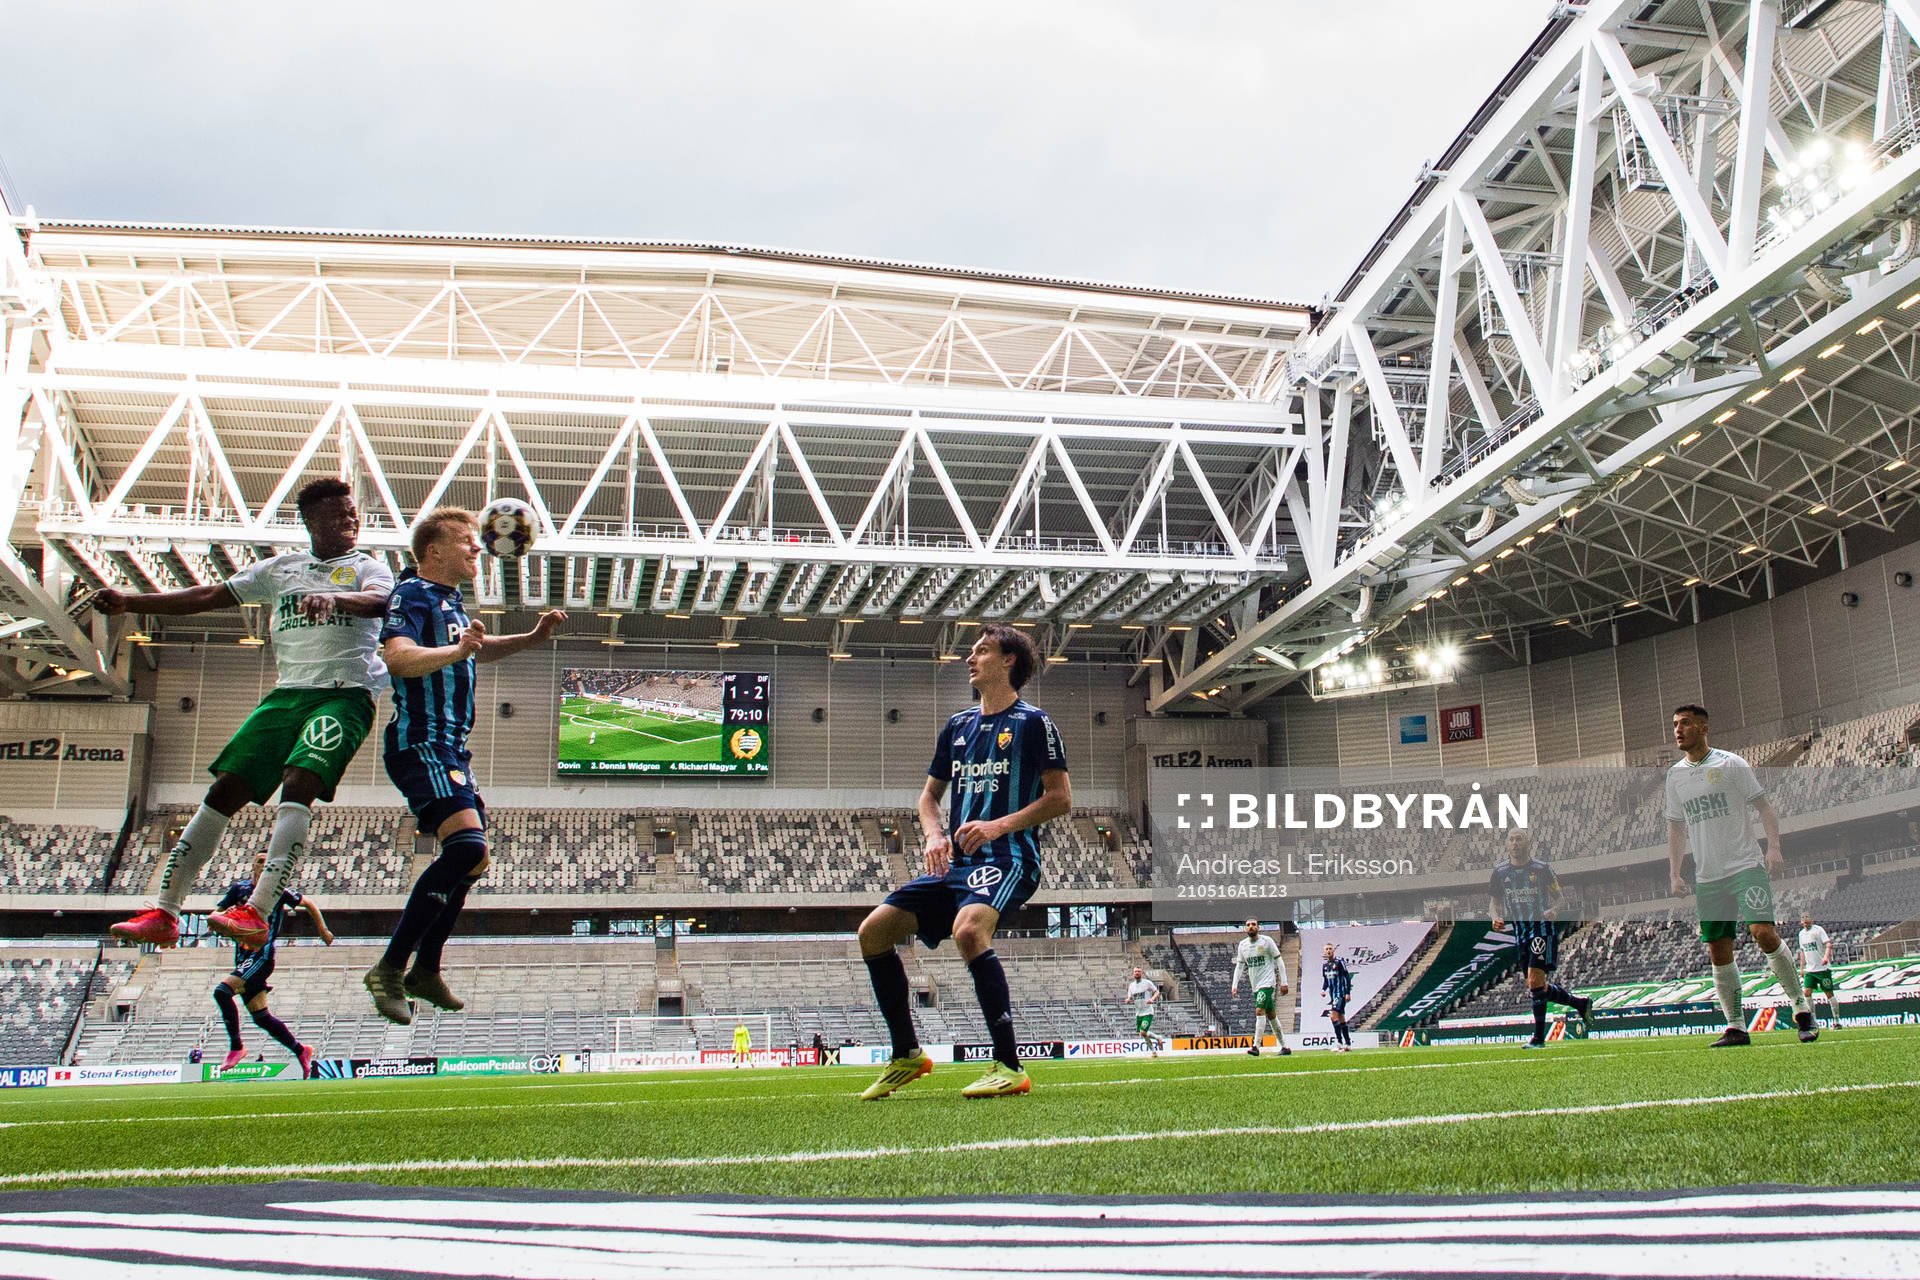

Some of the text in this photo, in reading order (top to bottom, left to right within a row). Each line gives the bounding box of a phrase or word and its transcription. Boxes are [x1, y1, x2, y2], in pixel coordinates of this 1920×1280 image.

[757, 675, 769, 683] DIF
[730, 685, 737, 699] 1
[754, 685, 764, 700] 2
[730, 708, 763, 721] 79:10
[1449, 711, 1471, 728] JOB
[1449, 728, 1475, 740] ZONE
[0, 738, 125, 761] TELE2 Arena
[1153, 750, 1254, 769] TELE2 Arena
[599, 762, 626, 770] Dennis
[709, 763, 737, 772] Magyar
[951, 758, 1010, 777] Prioritet
[957, 778, 999, 794] Finans
[1683, 792, 1729, 817] HUSKI
[1828, 1014, 1902, 1028] HMMARBYKORTET
[1082, 1041, 1166, 1055] INTERSPORT
[1303, 1037, 1337, 1046] CRAF
[704, 1053, 737, 1064] HUSK
[743, 1050, 815, 1064] CHOCOLTE
[964, 1042, 1054, 1058] METGOLV
[441, 1059, 528, 1072] AudicomPendax
[20, 1069, 47, 1086] BAR
[80, 1067, 178, 1079] Stena Fastigheter
